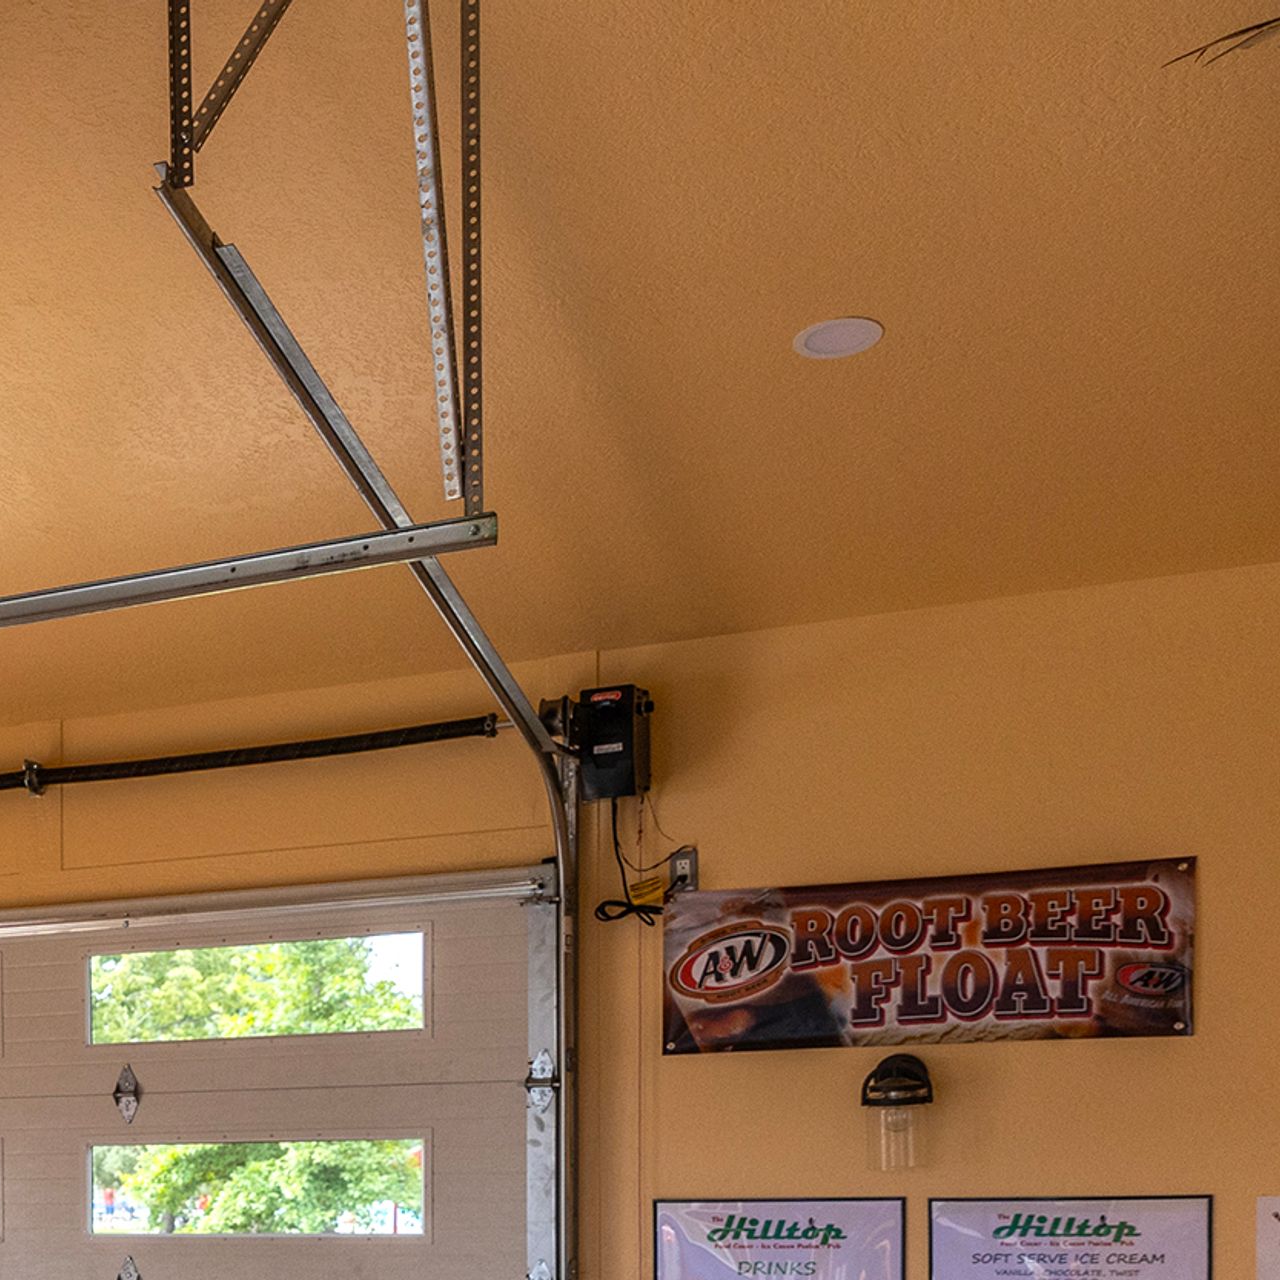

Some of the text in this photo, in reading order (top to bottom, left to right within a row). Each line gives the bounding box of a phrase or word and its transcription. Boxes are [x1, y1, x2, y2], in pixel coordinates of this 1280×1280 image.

[791, 887, 1174, 970] ROOT BEER
[697, 933, 769, 989] A&W
[850, 949, 1101, 1028] FLOAT
[706, 1214, 847, 1245] Hilltop
[992, 1212, 1142, 1243] Hilltop
[737, 1260, 816, 1276] DRINKS
[971, 1253, 1012, 1264] SOFT
[1074, 1253, 1100, 1264] ICE
[1105, 1253, 1166, 1264] CREAM
